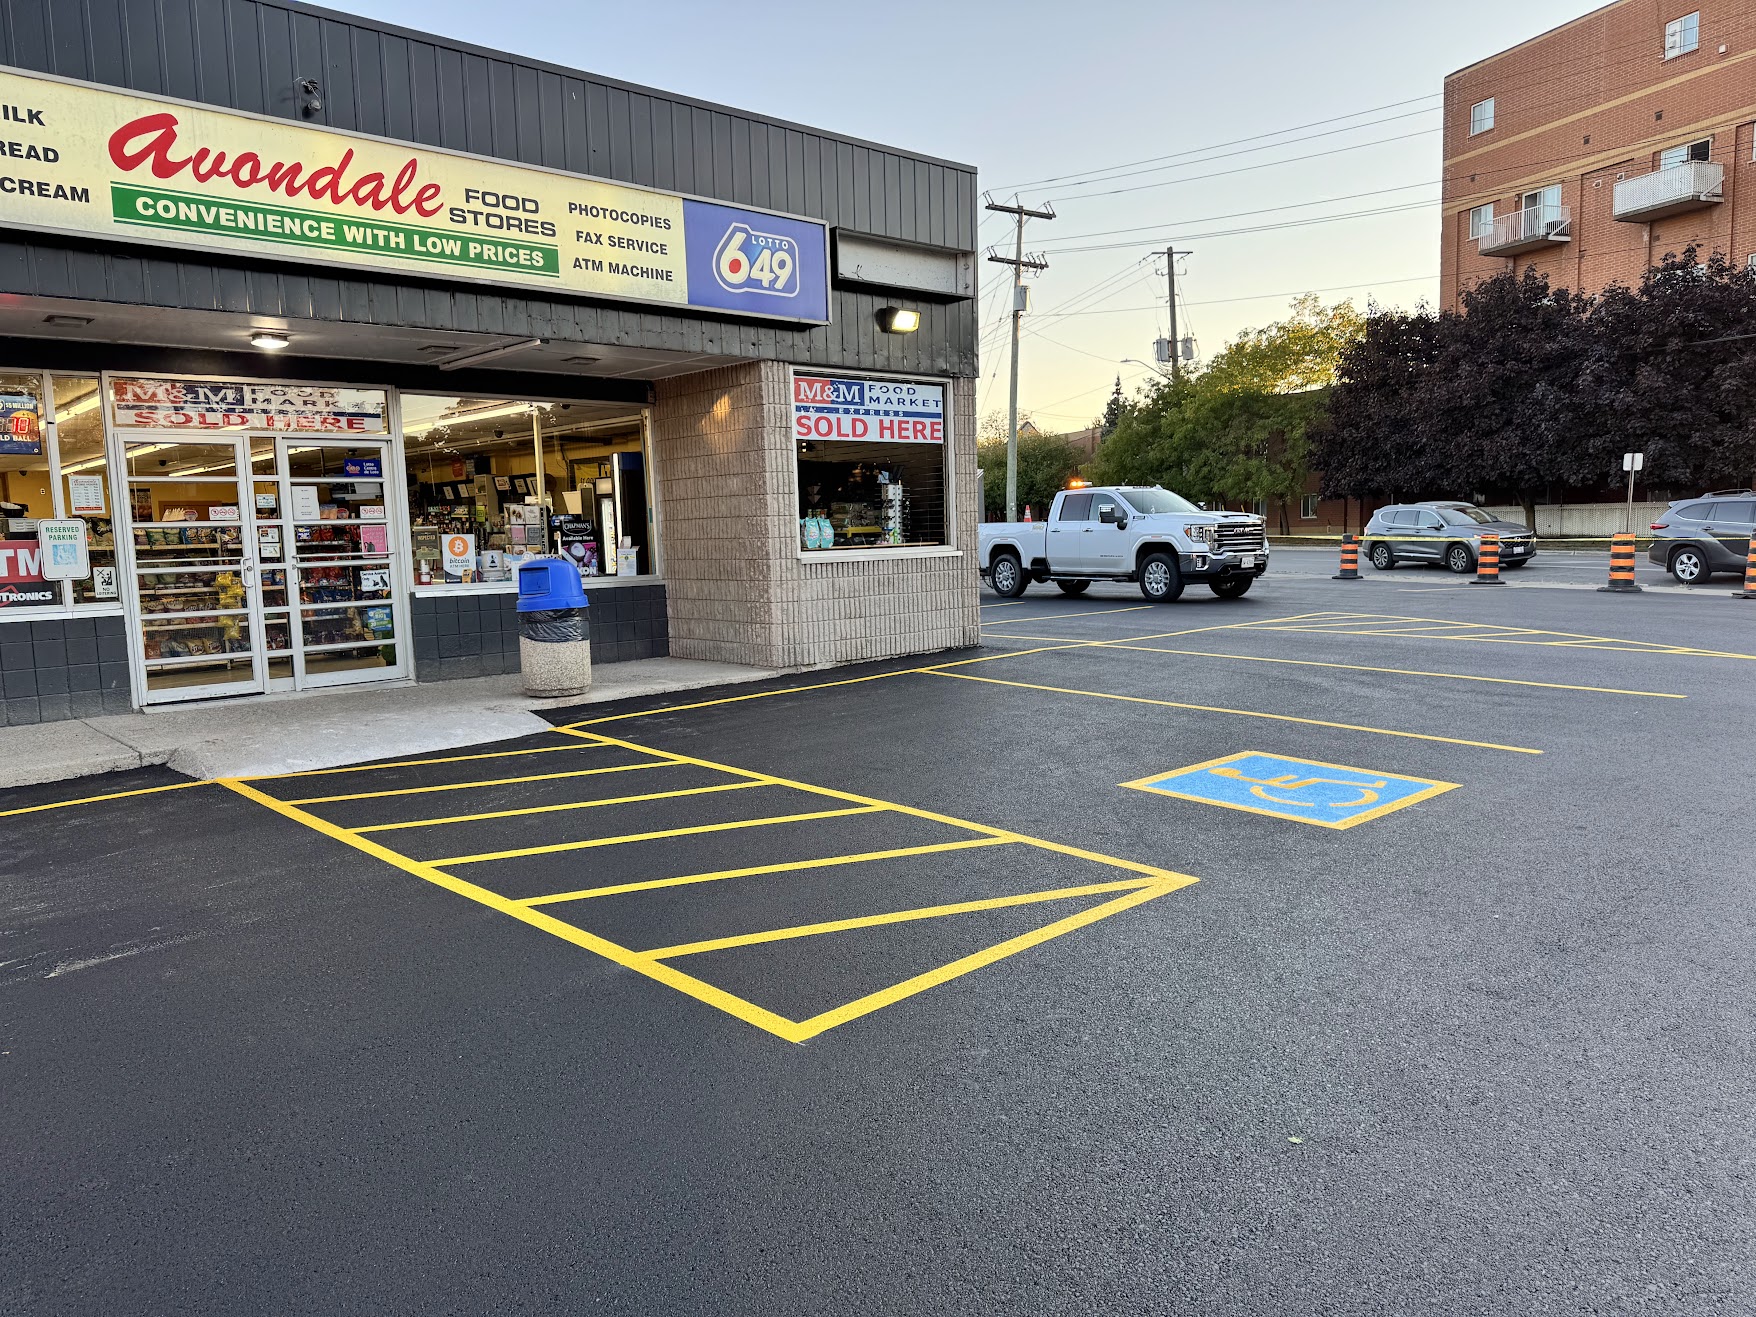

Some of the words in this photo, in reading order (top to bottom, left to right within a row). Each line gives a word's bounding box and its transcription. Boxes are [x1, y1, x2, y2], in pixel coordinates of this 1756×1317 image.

[2, 104, 46, 127] ILK
[108, 112, 444, 218] Avondale
[0, 176, 90, 203] CREAM
[464, 187, 540, 214] FOOD
[449, 207, 557, 238] STORES
[568, 201, 672, 230] PHOTOCOPIES
[135, 196, 336, 240] CONVENIENCE
[343, 224, 406, 250] WITH
[413, 234, 462, 256] LOW
[468, 241, 545, 267] PRICES
[575, 230, 604, 246] FAX
[607, 235, 668, 256] SERVICE
[751, 235, 789, 249] LOTTO
[572, 257, 603, 272] ATM
[608, 261, 674, 282] MACHINE
[798, 381, 861, 403] M&M
[868, 384, 916, 396] FOOD
[868, 395, 942, 408] MARKET
[134, 411, 250, 426] SOLD
[265, 414, 366, 430] HERE
[838, 407, 904, 417] EXPRESS
[796, 415, 869, 438] SOLD
[878, 418, 942, 441] HERE
[0, 591, 53, 602] TRONICS
